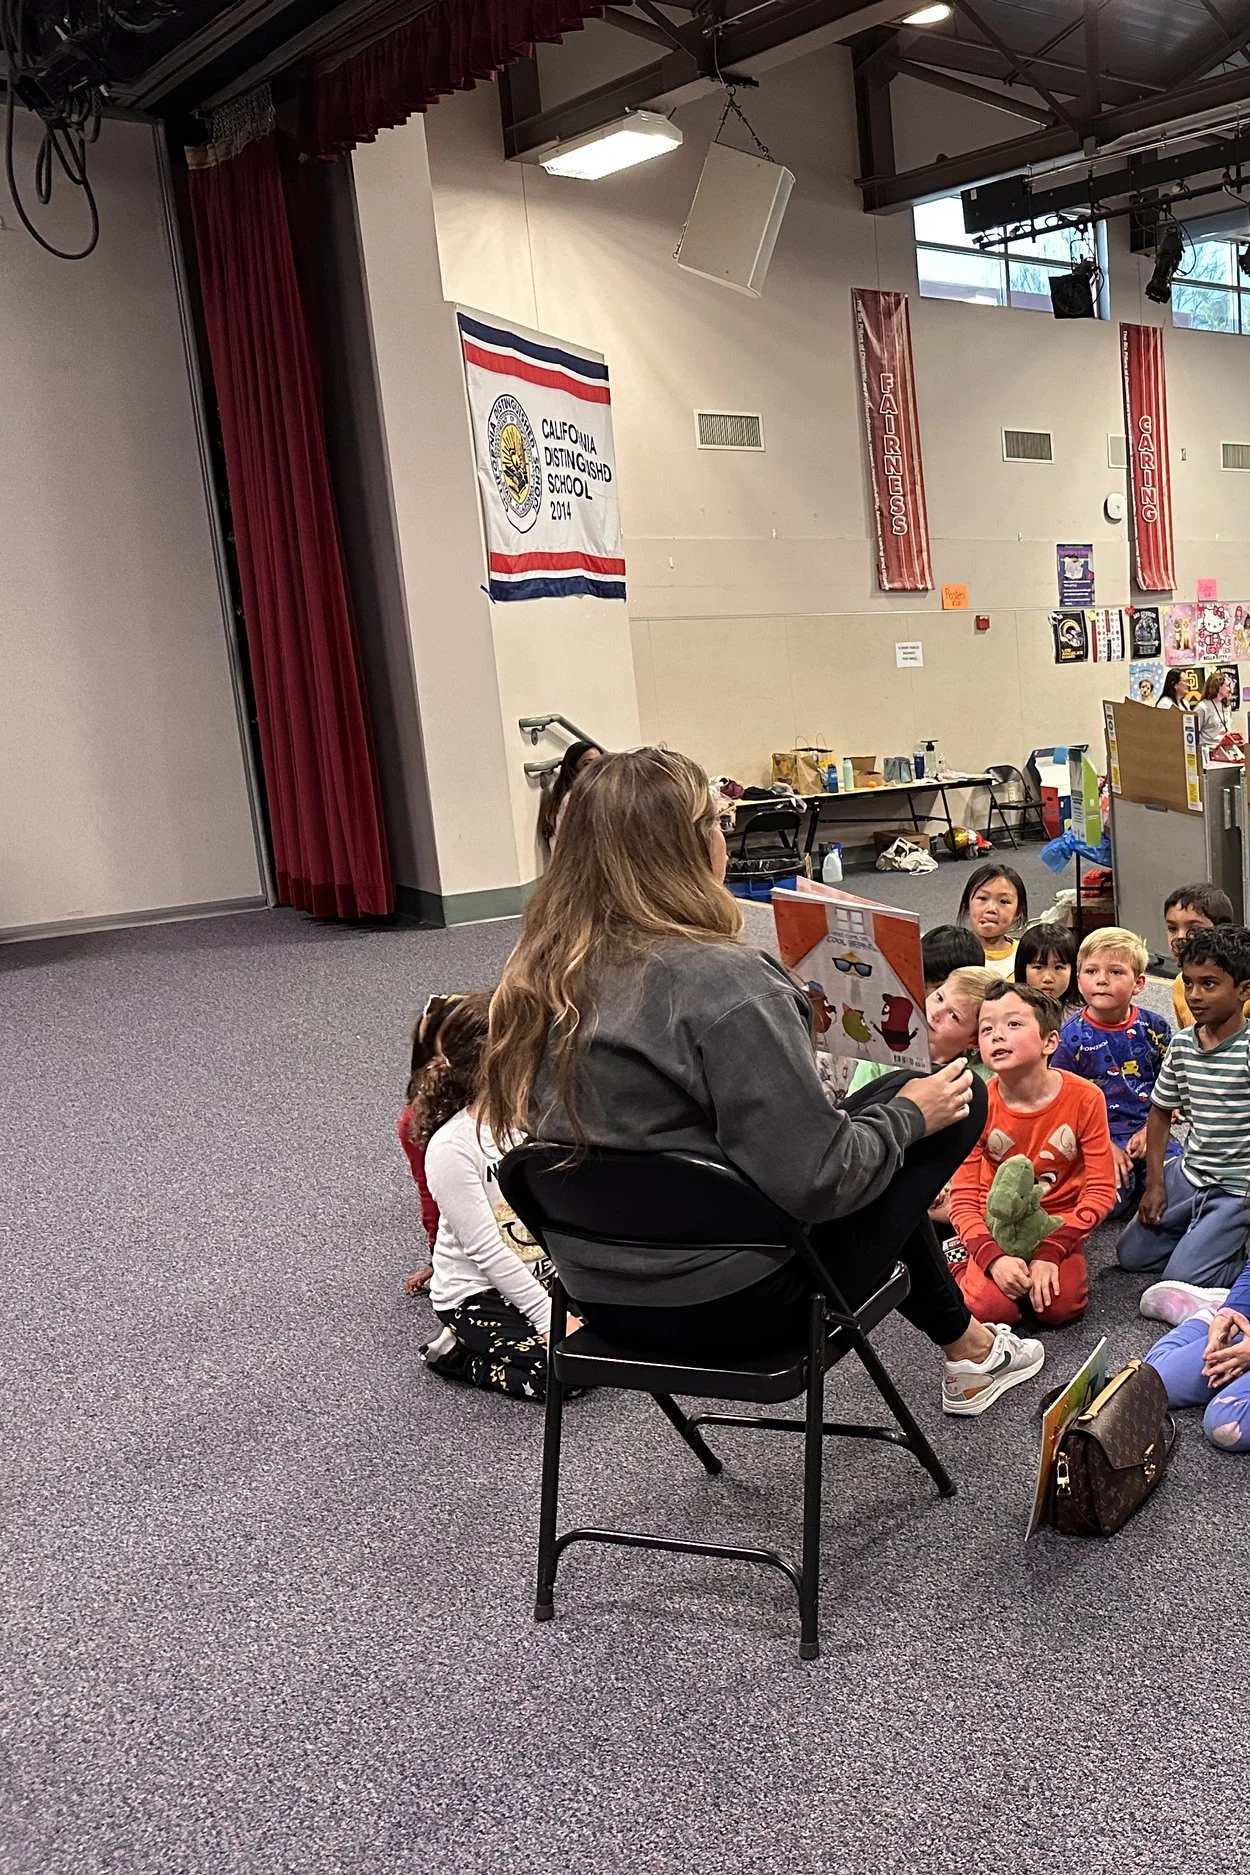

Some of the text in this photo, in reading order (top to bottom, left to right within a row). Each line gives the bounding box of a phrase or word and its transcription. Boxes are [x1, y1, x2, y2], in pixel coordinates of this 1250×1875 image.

[542, 418, 597, 455] CALIFONIA
[879, 372, 908, 536] FAIRNESS
[1138, 415, 1159, 523] CARING
[547, 473, 593, 500] SCHOOL
[550, 501, 572, 520] 2014
[826, 935, 847, 946] COOL
